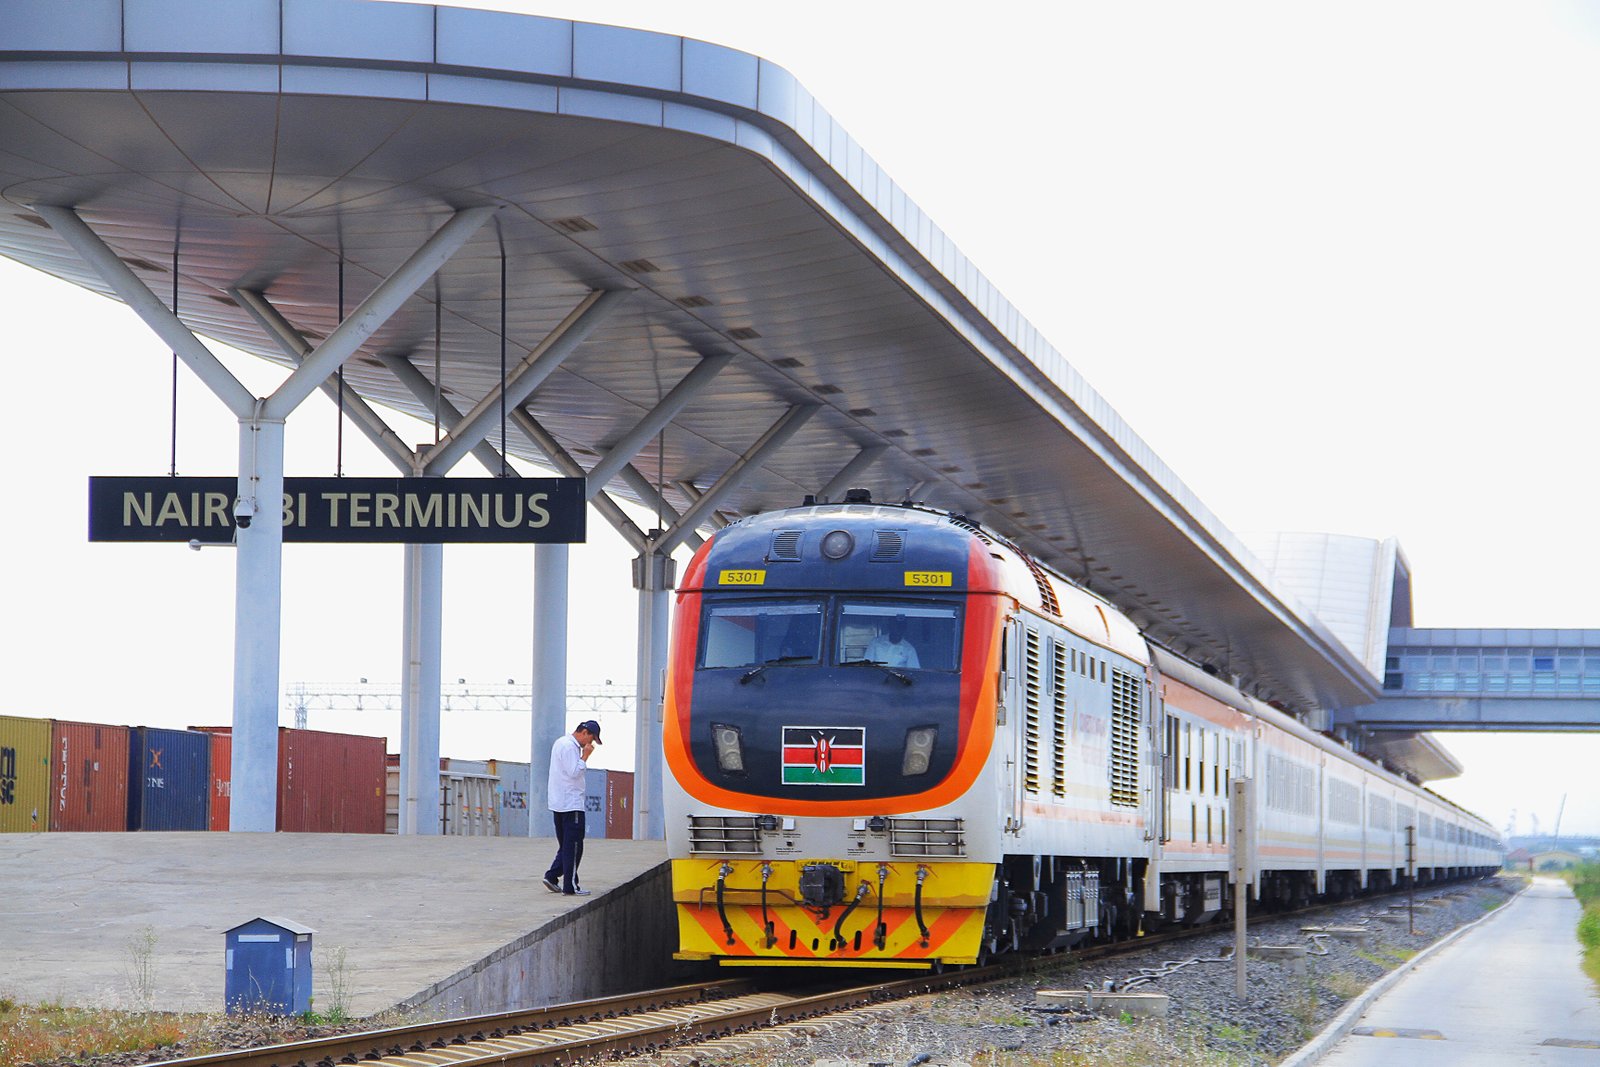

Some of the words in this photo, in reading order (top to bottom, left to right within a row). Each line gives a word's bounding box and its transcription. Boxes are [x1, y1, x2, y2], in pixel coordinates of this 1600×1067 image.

[123, 492, 307, 527] NAIRBI
[322, 492, 551, 529] TERMINUS
[727, 572, 758, 582] 5301
[912, 574, 944, 584] 5301
